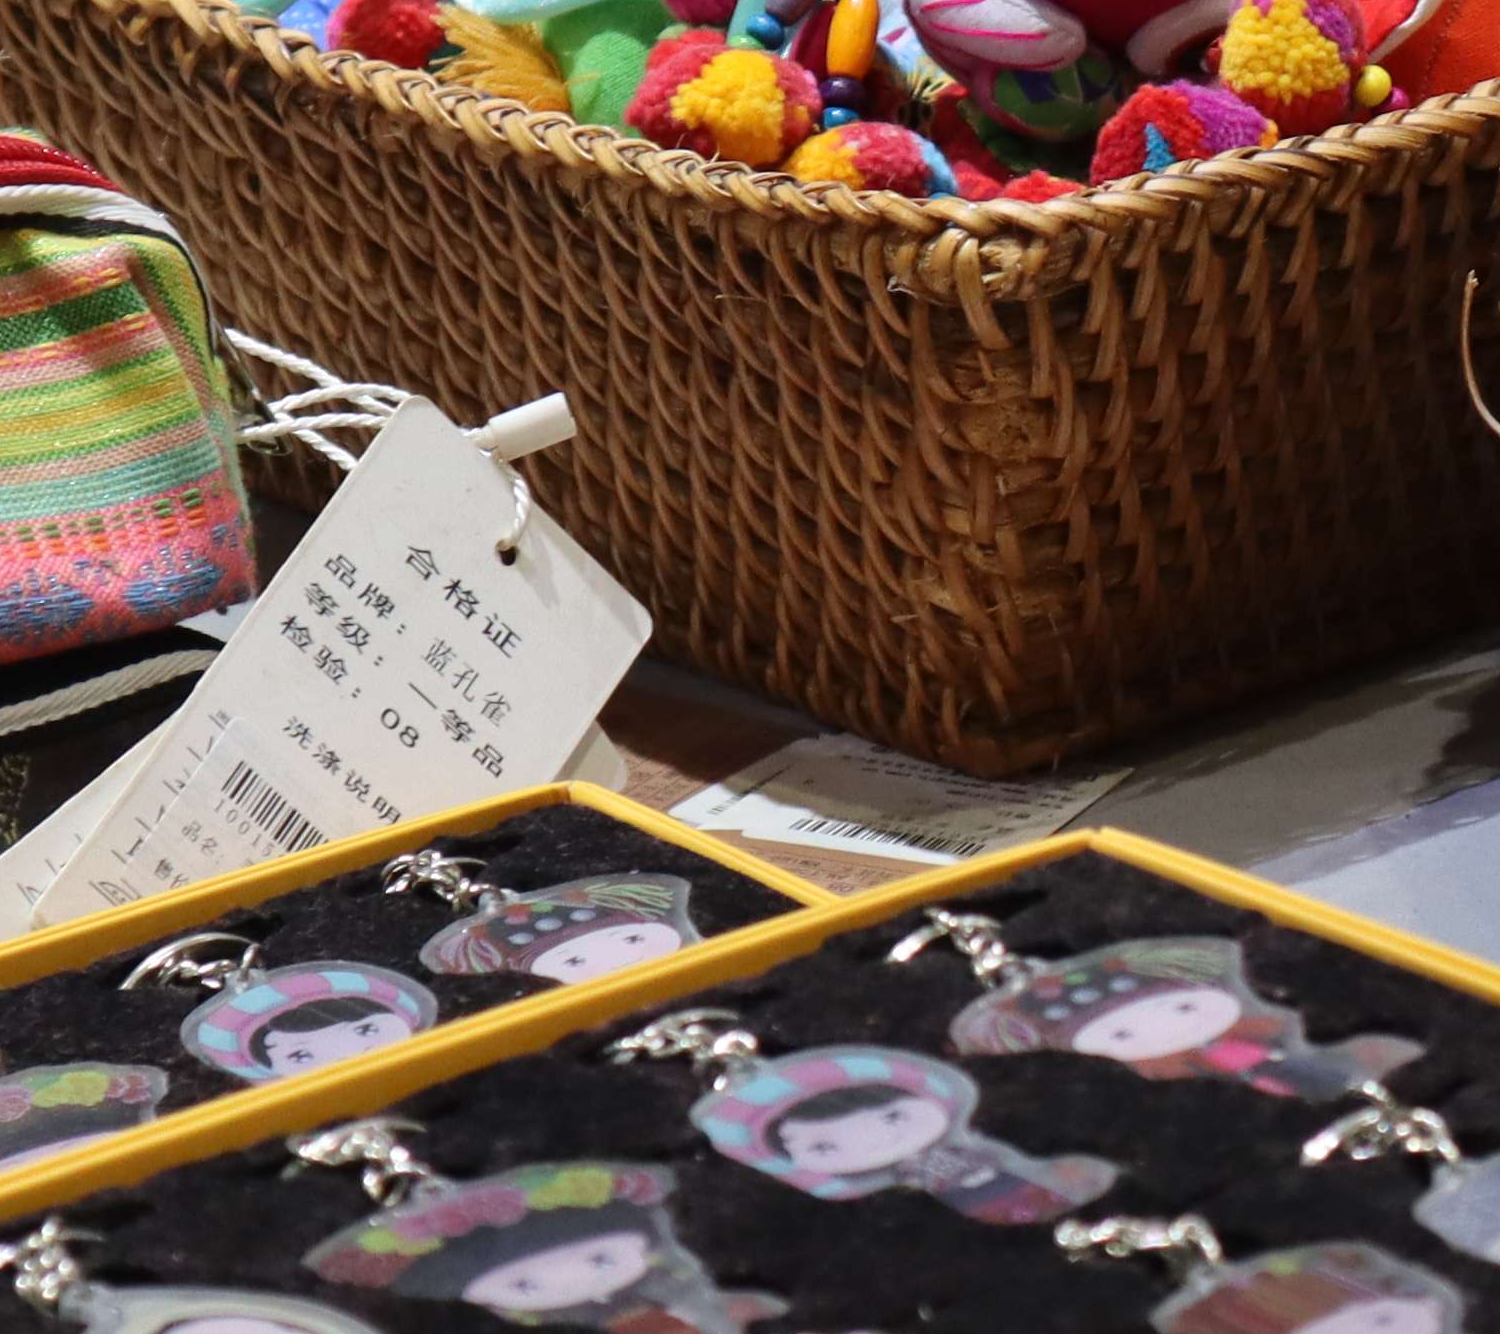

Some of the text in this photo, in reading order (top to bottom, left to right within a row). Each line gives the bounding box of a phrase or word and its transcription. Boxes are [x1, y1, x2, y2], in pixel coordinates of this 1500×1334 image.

[324, 554, 511, 727] 品牌： 蓝孔雀
[405, 545, 522, 659] 合格证
[280, 616, 419, 748] 检验： 08
[304, 582, 504, 778] 等级： 一等品
[214, 799, 284, 858] 10015
[283, 715, 401, 824] 洗涤说明
